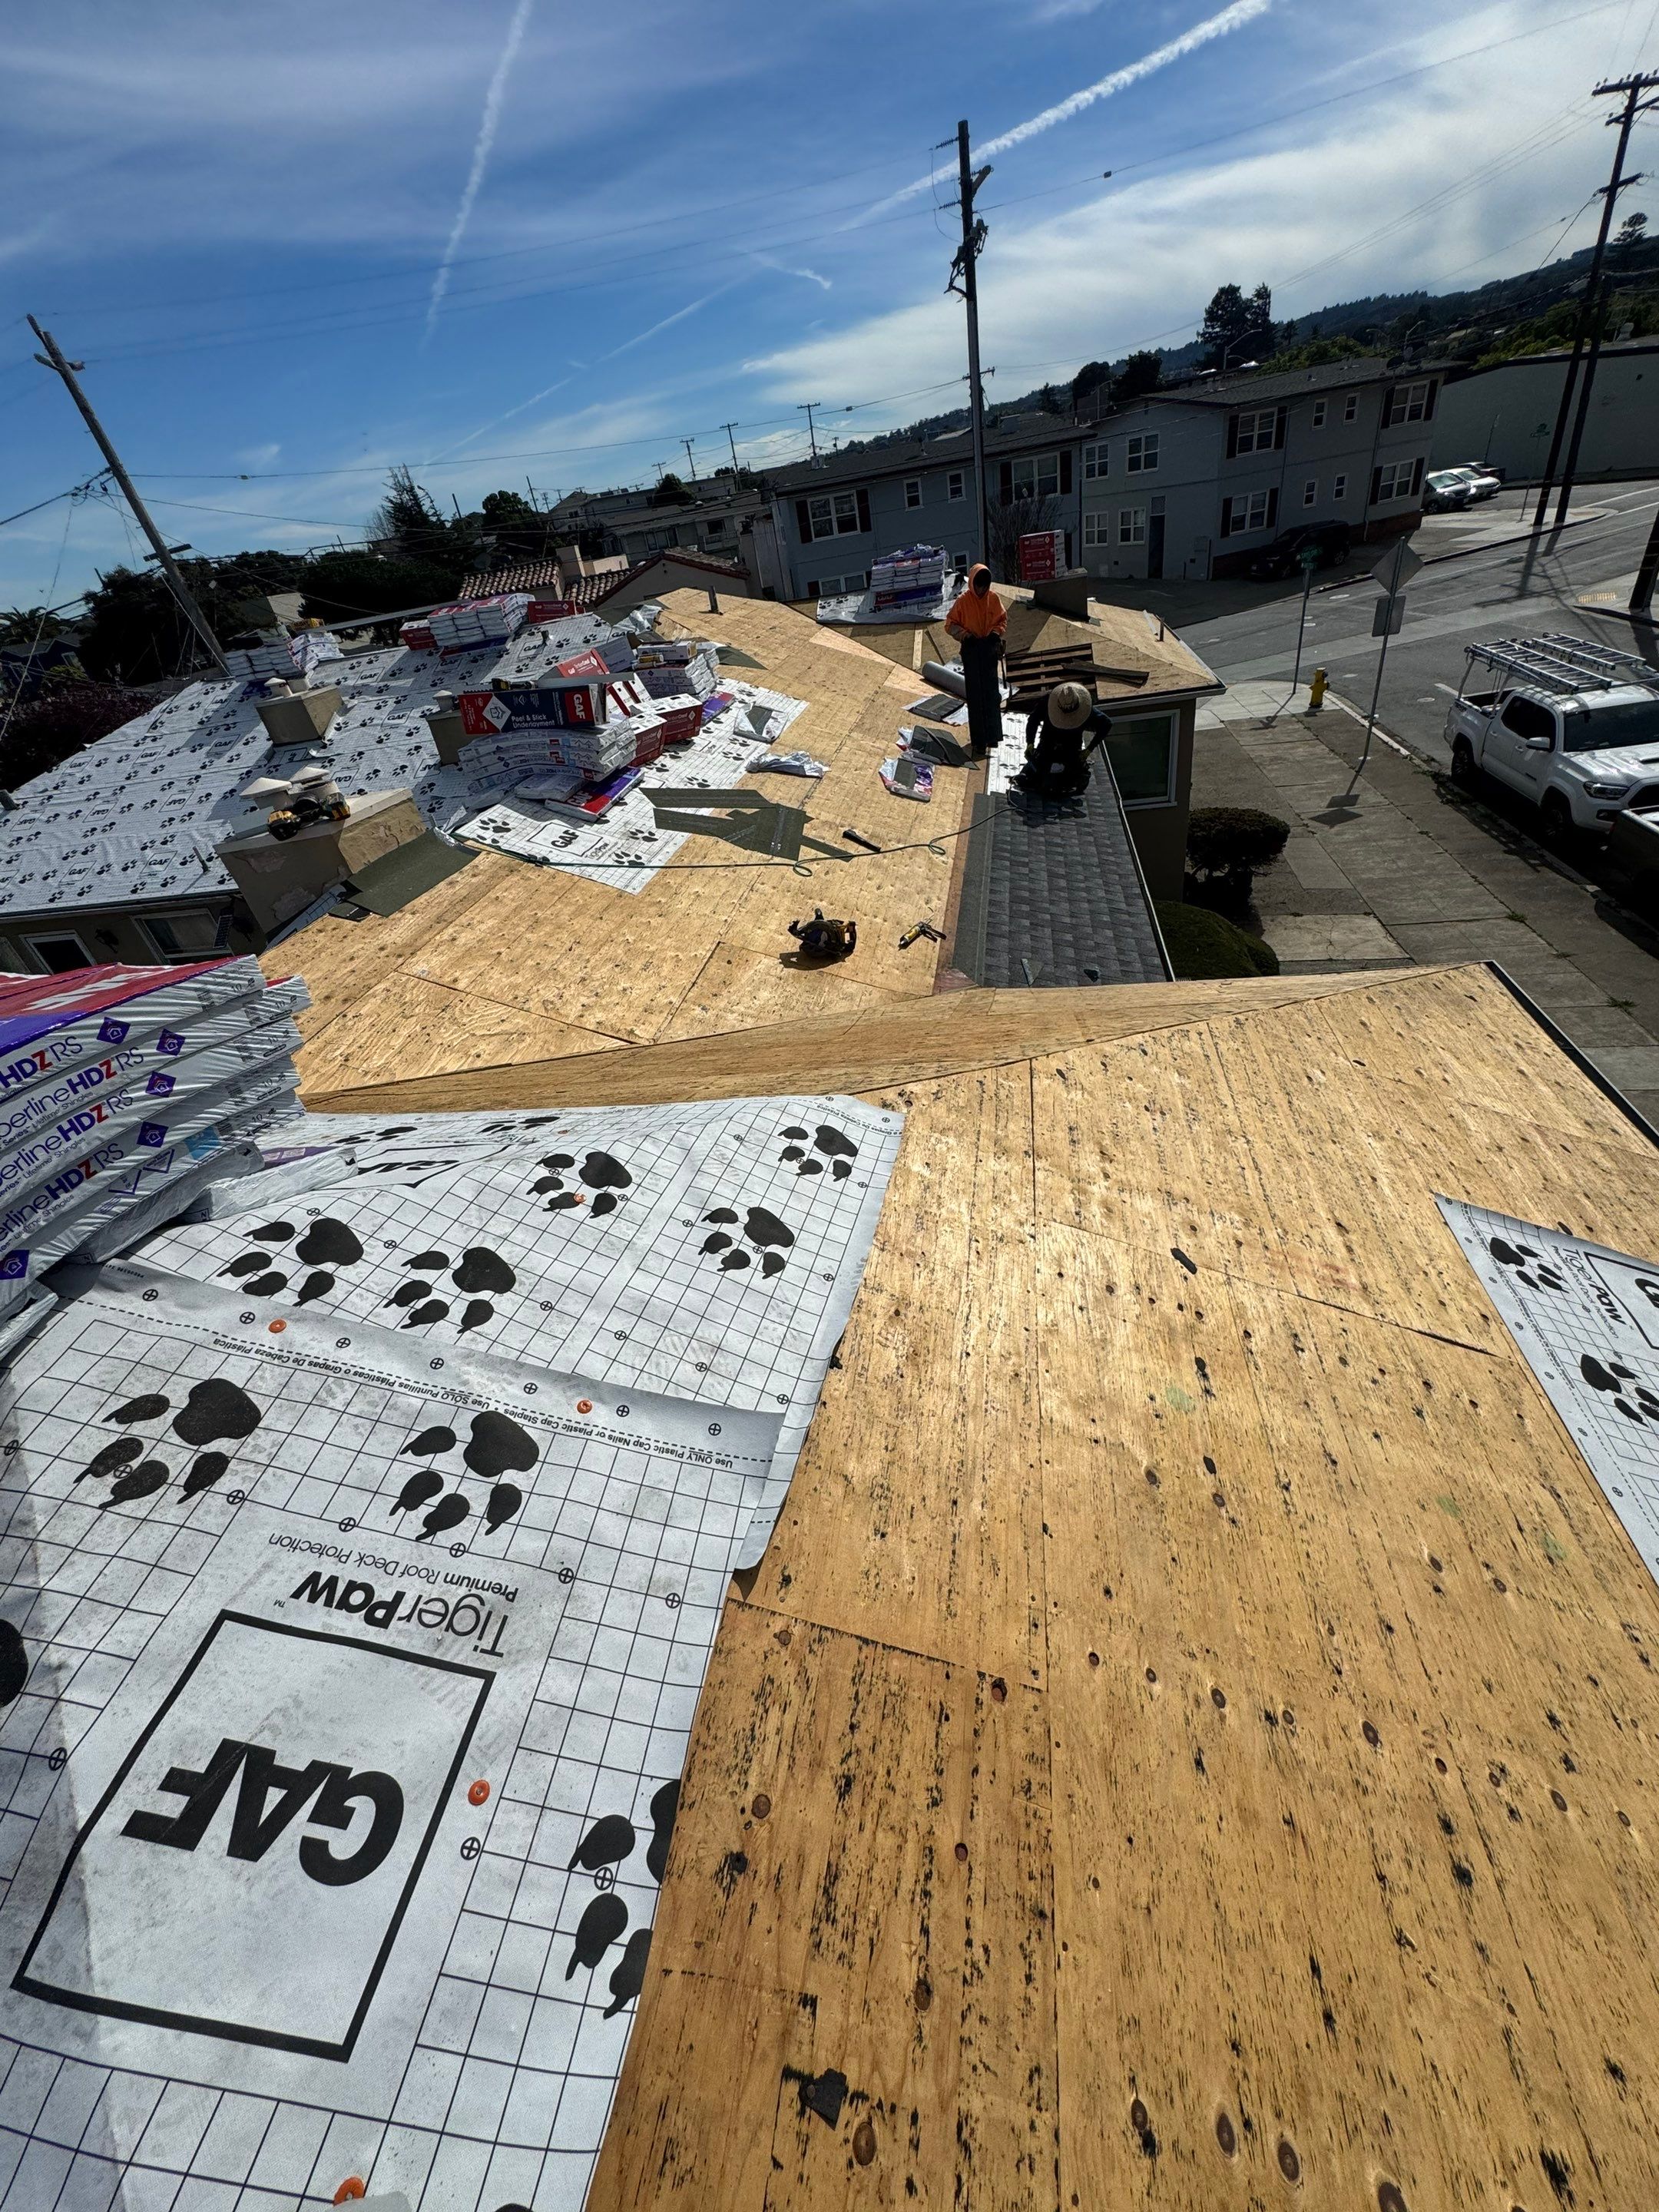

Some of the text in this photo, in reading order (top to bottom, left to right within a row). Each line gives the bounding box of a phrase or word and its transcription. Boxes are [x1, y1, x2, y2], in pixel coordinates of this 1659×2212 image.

[573, 694, 586, 720] GAF
[551, 830, 579, 848] GAF
[1563, 1249, 1627, 1325] TigerPaw
[213, 1338, 253, 1354] Plástica
[254, 1349, 290, 1364] Cabeza
[292, 1357, 306, 1366] De
[307, 1360, 343, 1375] Grapas
[353, 1370, 396, 1388] Plásticas
[398, 1382, 440, 1398] Puntillas
[441, 1391, 472, 1405] SÓLO
[472, 1398, 490, 1409] Use
[504, 1407, 538, 1424] Staples
[541, 1418, 559, 1429] Cap
[561, 1424, 594, 1437] Plastic
[594, 1431, 607, 1439] or
[608, 1433, 631, 1447] Nails
[633, 1440, 651, 1451] Cap
[653, 1445, 684, 1459] Plastic
[687, 1449, 713, 1465] ONLY
[715, 1457, 733, 1469] Use
[268, 1532, 519, 1603] Premium Roof Deck Protection
[290, 1570, 508, 1657] TigerPaw
[119, 1738, 404, 1886] GAF
